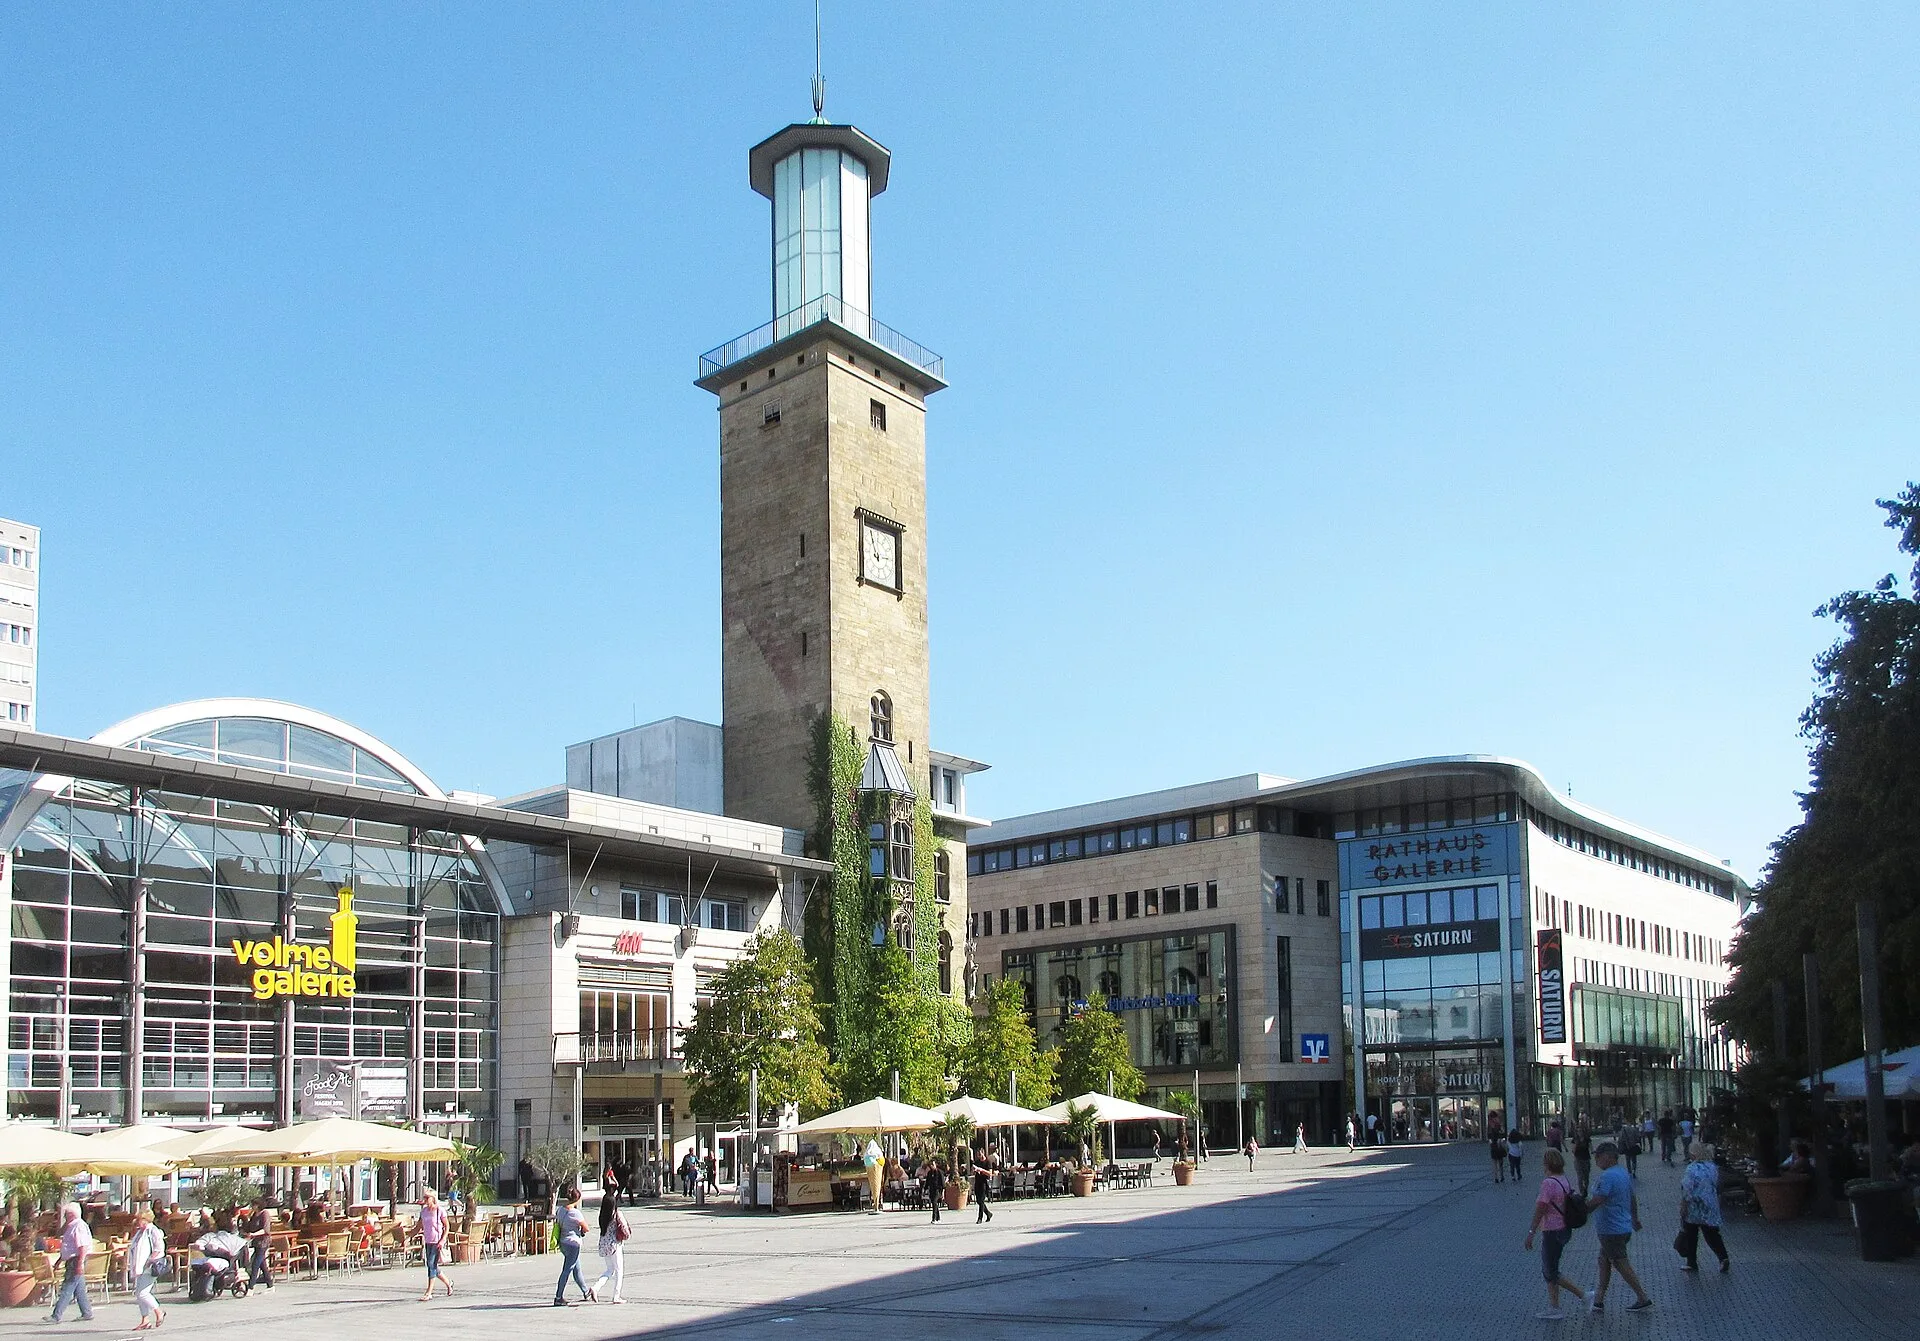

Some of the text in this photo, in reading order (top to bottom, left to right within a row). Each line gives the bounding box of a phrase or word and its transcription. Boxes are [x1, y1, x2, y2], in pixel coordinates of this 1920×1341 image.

[1369, 832, 1485, 860] RATHAUS
[1373, 856, 1482, 881] GALERIE
[615, 930, 643, 955] H&M
[1413, 929, 1472, 948] SATURN
[232, 935, 332, 970] volme
[253, 963, 357, 1000] galerie
[1107, 991, 1200, 1011] ärkische Bank
[1540, 969, 1563, 1039] SATURN
[1439, 1071, 1491, 1087] SATURN
